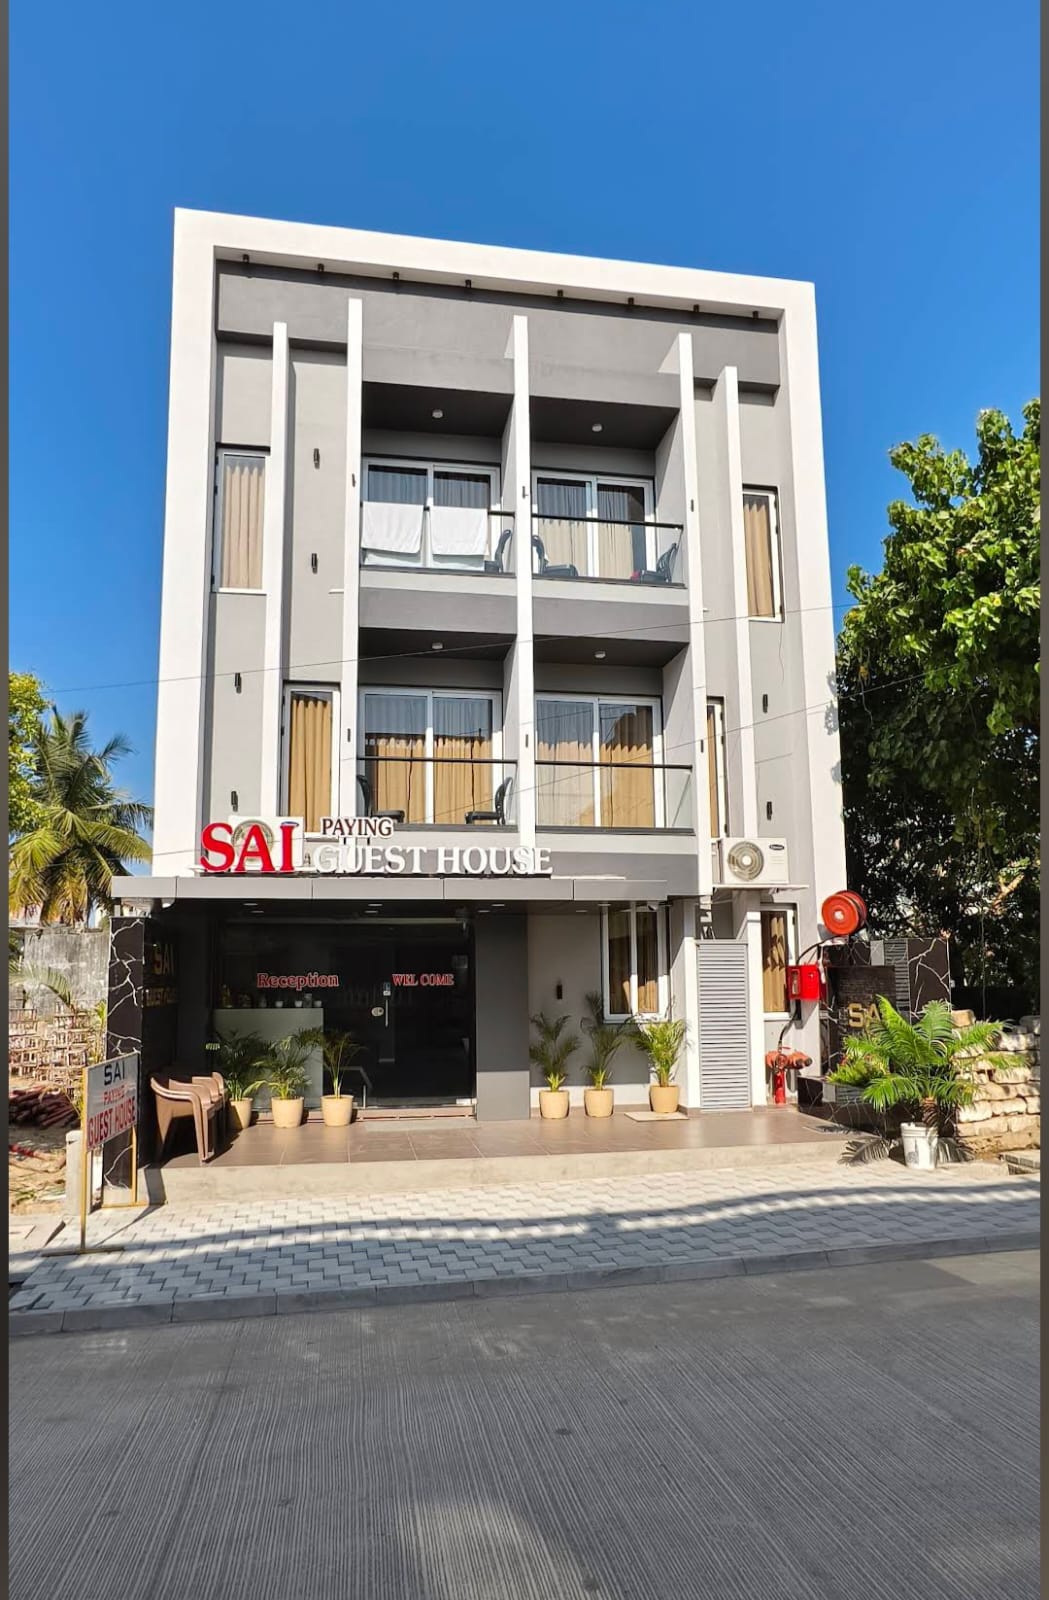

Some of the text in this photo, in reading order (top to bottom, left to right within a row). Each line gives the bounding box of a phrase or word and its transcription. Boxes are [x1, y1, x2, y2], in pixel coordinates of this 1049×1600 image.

[321, 817, 393, 838] PAYING
[200, 822, 297, 873] SAI
[312, 845, 553, 875] GUEST HOUSE
[257, 972, 339, 991] Reception
[849, 1003, 880, 1027] SA
[104, 1060, 125, 1086] SAI
[88, 1096, 136, 1147] GUEST HOUSE
